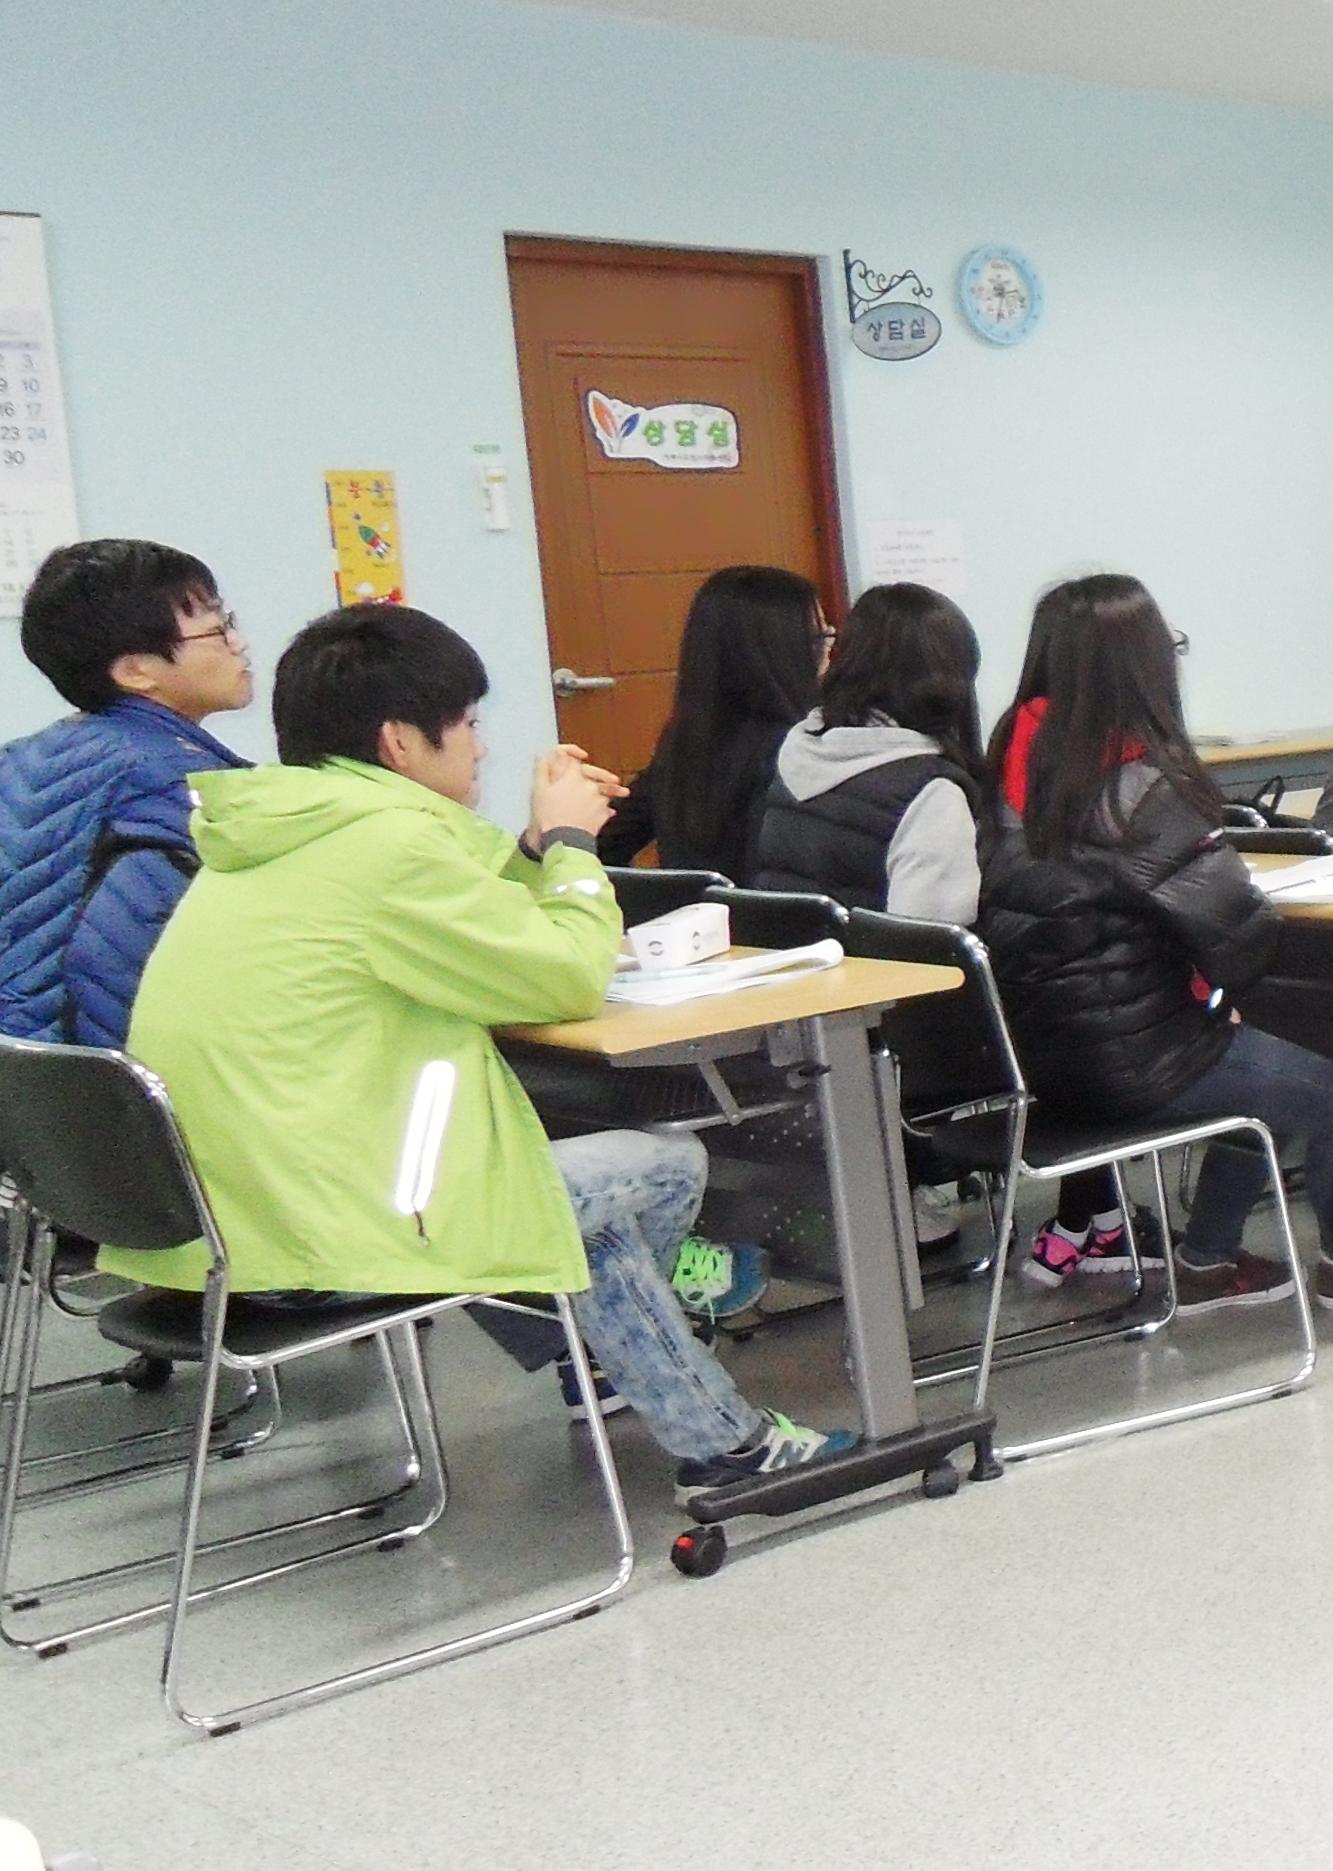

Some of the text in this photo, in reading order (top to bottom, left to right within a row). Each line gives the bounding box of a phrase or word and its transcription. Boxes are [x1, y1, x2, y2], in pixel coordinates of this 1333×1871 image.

[867, 316, 926, 342] 상담실
[0, 425, 21, 441] 23
[643, 419, 731, 447] 상담실
[3, 449, 25, 465] 30
